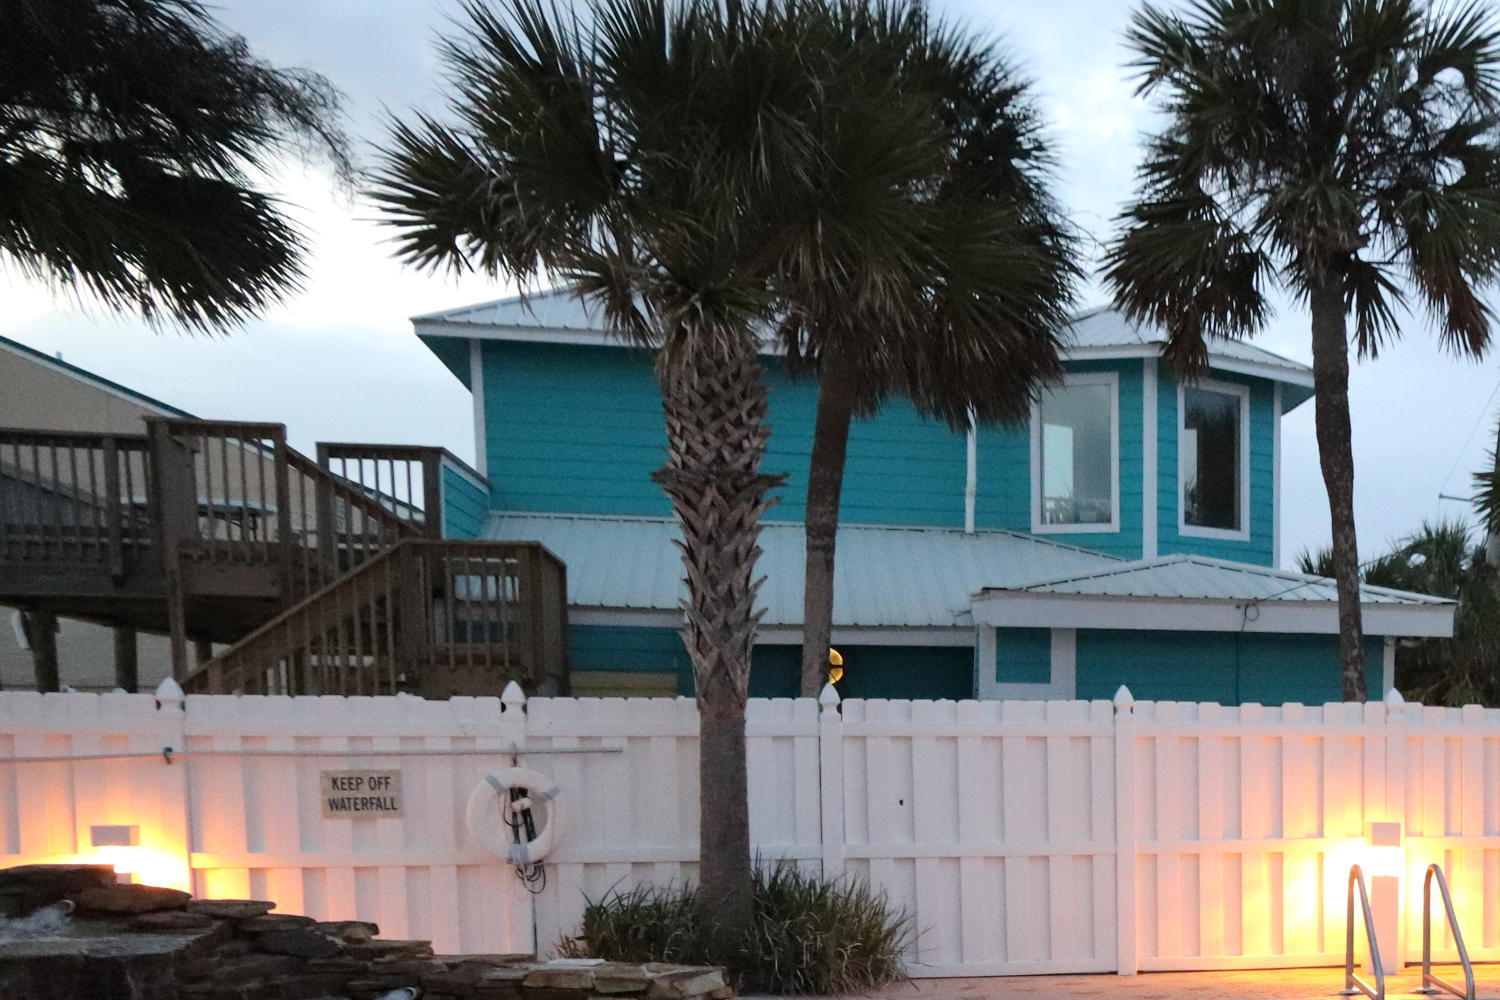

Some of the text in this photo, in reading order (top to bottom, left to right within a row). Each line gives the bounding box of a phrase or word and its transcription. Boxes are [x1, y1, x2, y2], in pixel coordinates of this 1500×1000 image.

[331, 776, 391, 791] KEEP OFF
[328, 797, 398, 811] WATERFALL
